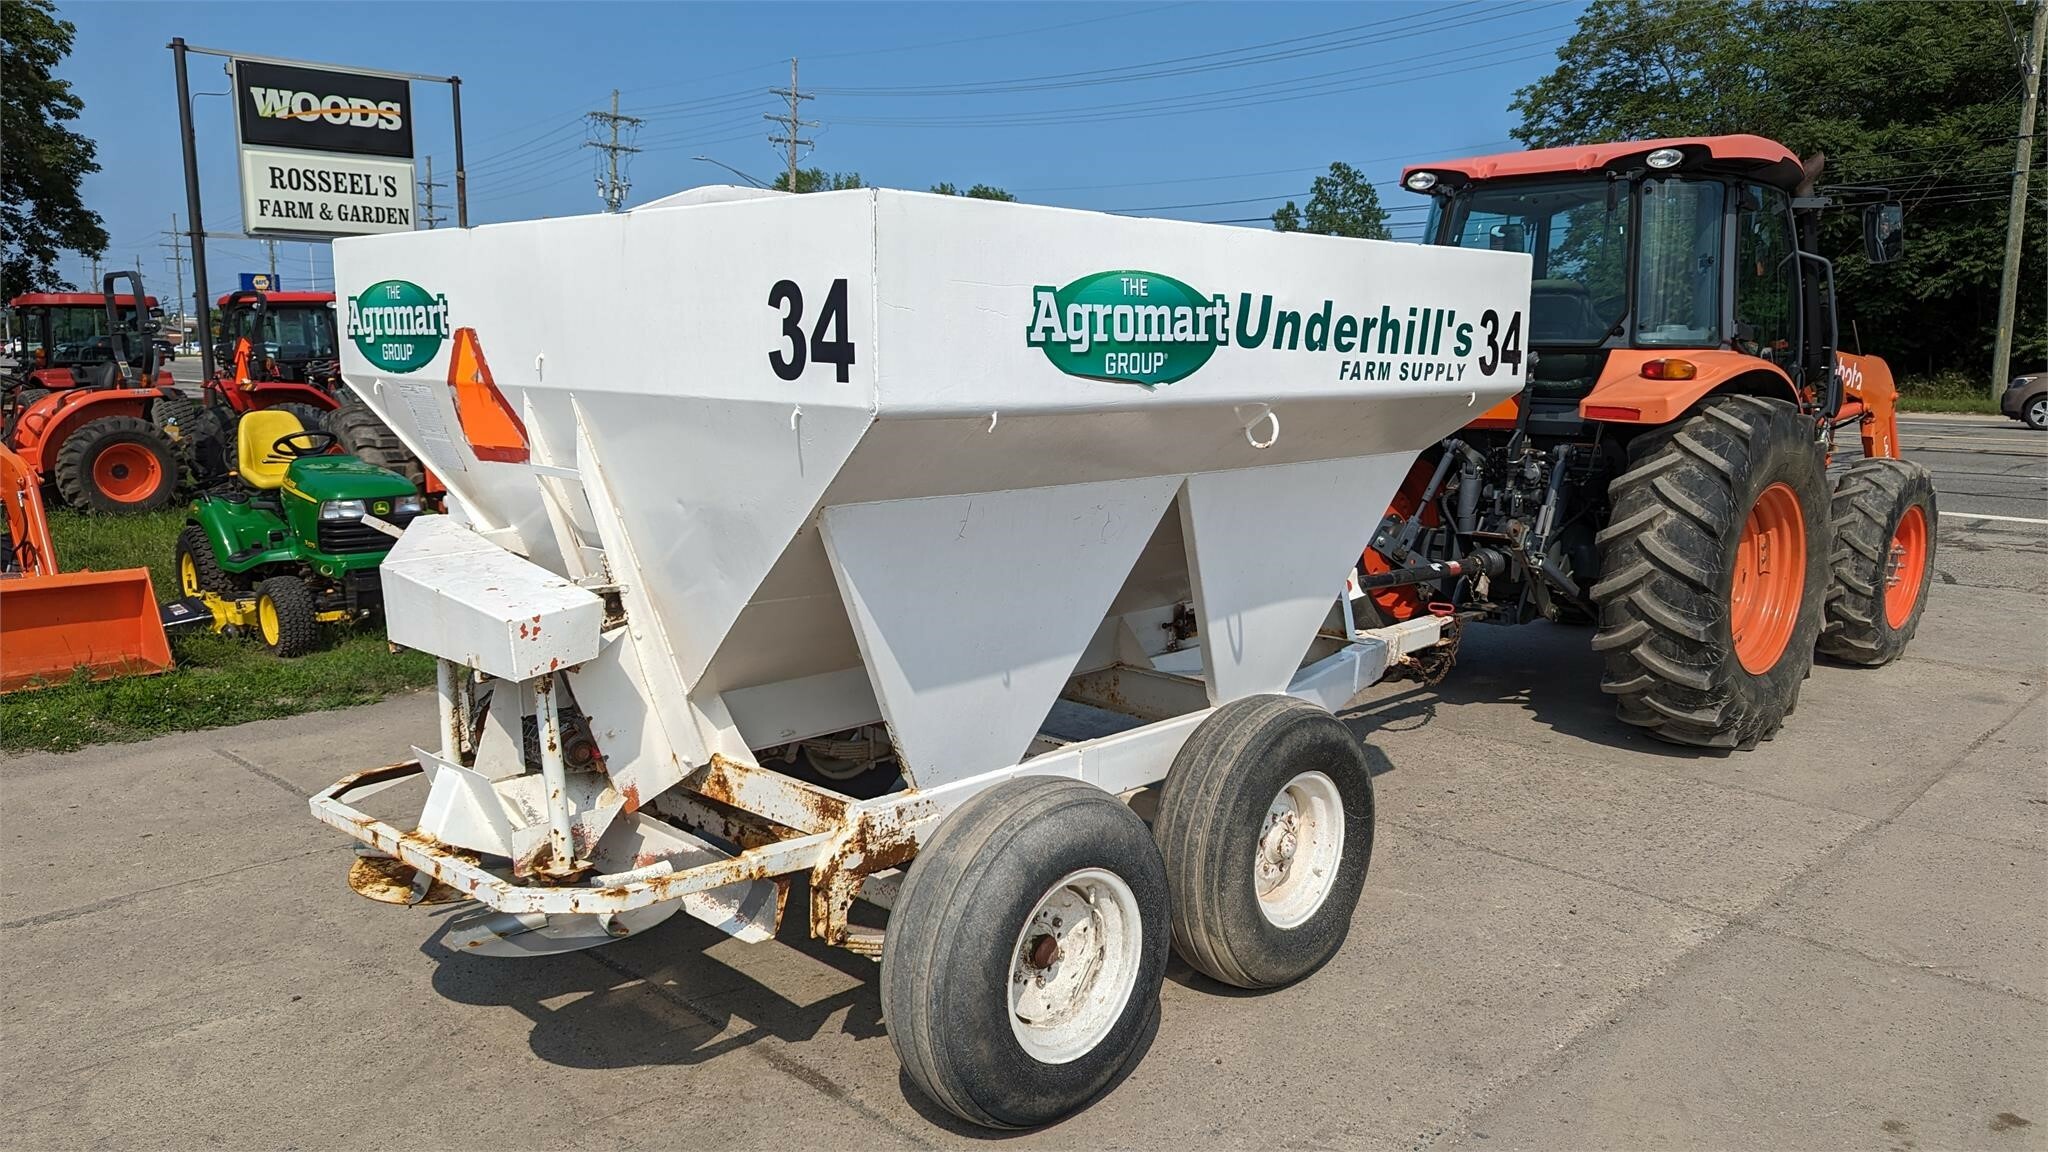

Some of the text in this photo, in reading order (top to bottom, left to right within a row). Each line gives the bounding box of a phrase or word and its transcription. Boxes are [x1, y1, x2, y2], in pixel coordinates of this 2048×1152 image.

[250, 86, 403, 131] WOODS
[268, 166, 398, 198] ROSSEEL'S
[258, 199, 410, 226] FARM & GARDEN
[385, 285, 401, 300] THE
[1120, 277, 1149, 297] THE
[347, 297, 448, 344] Agromart
[767, 278, 856, 384] 34
[1029, 291, 1523, 377] Agromart Underhill's 34
[1339, 360, 1468, 382] FARM SUPPLY
[1834, 356, 1863, 391] bota
